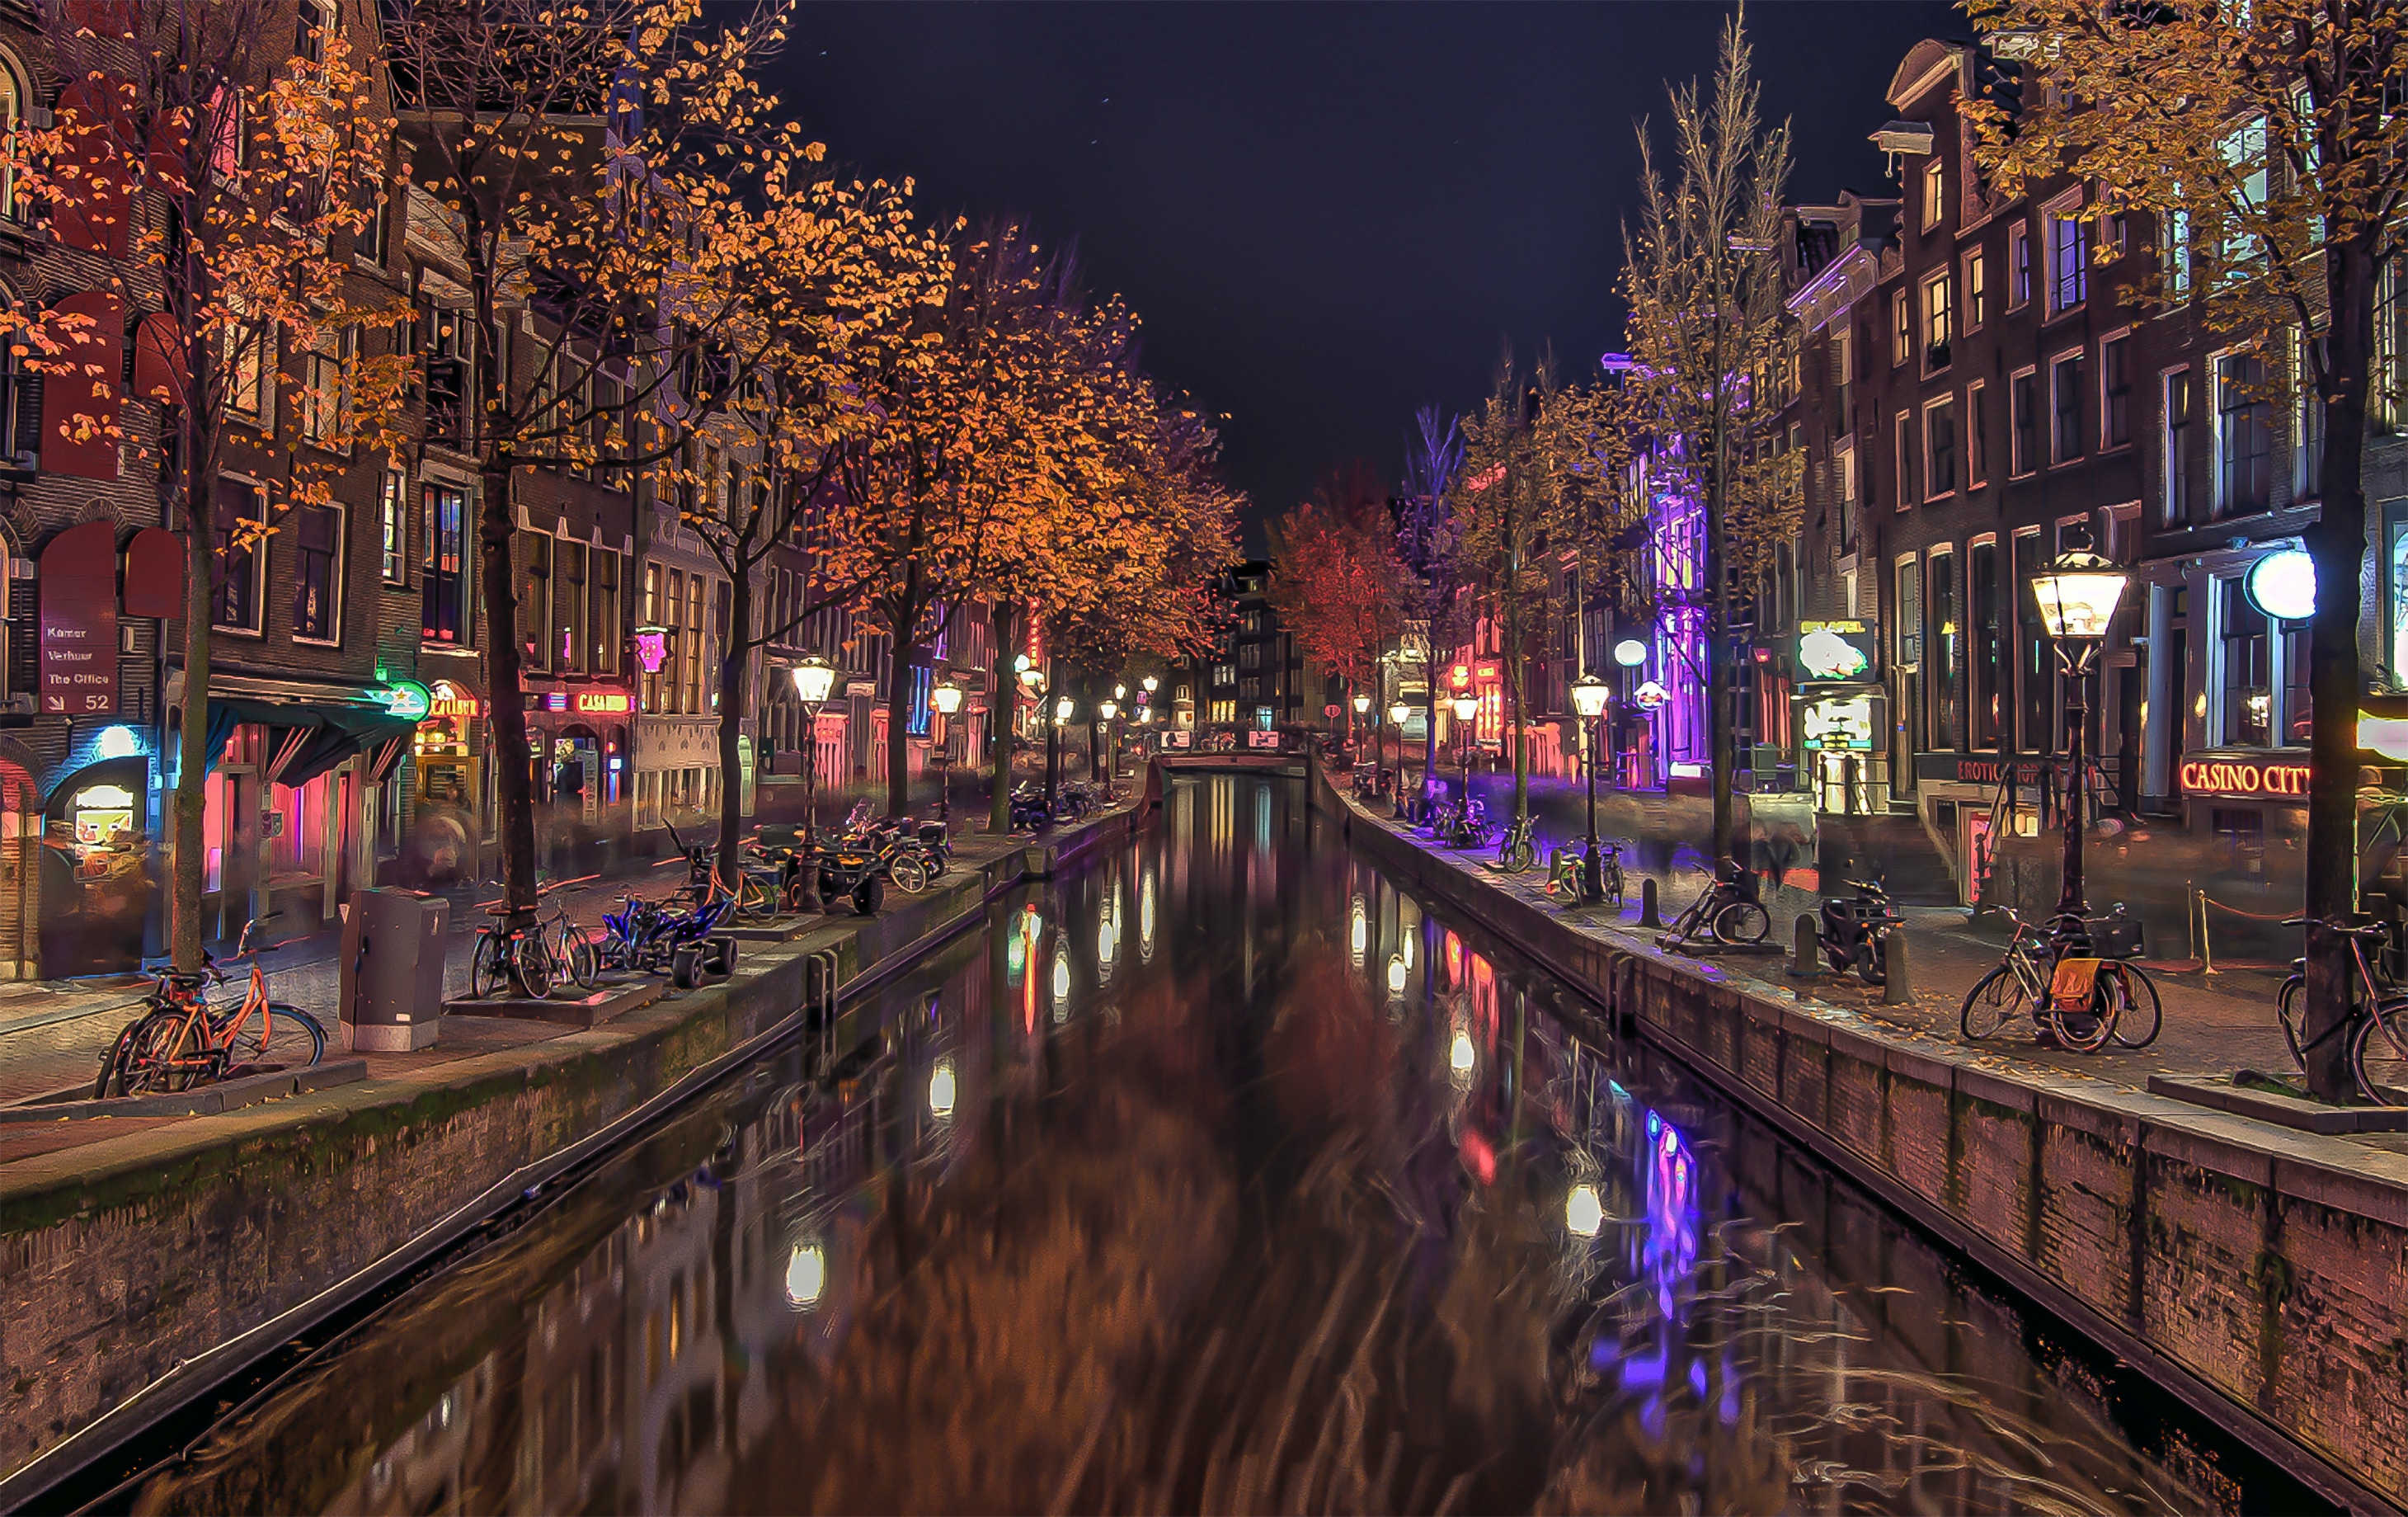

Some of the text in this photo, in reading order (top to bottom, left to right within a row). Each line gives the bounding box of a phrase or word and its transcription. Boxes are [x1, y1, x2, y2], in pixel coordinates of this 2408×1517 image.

[47, 626, 87, 638] Kamer
[48, 650, 92, 661] Verhuur
[48, 673, 109, 685] The Office
[85, 695, 109, 710] 52
[2182, 762, 2260, 793] CASINO
